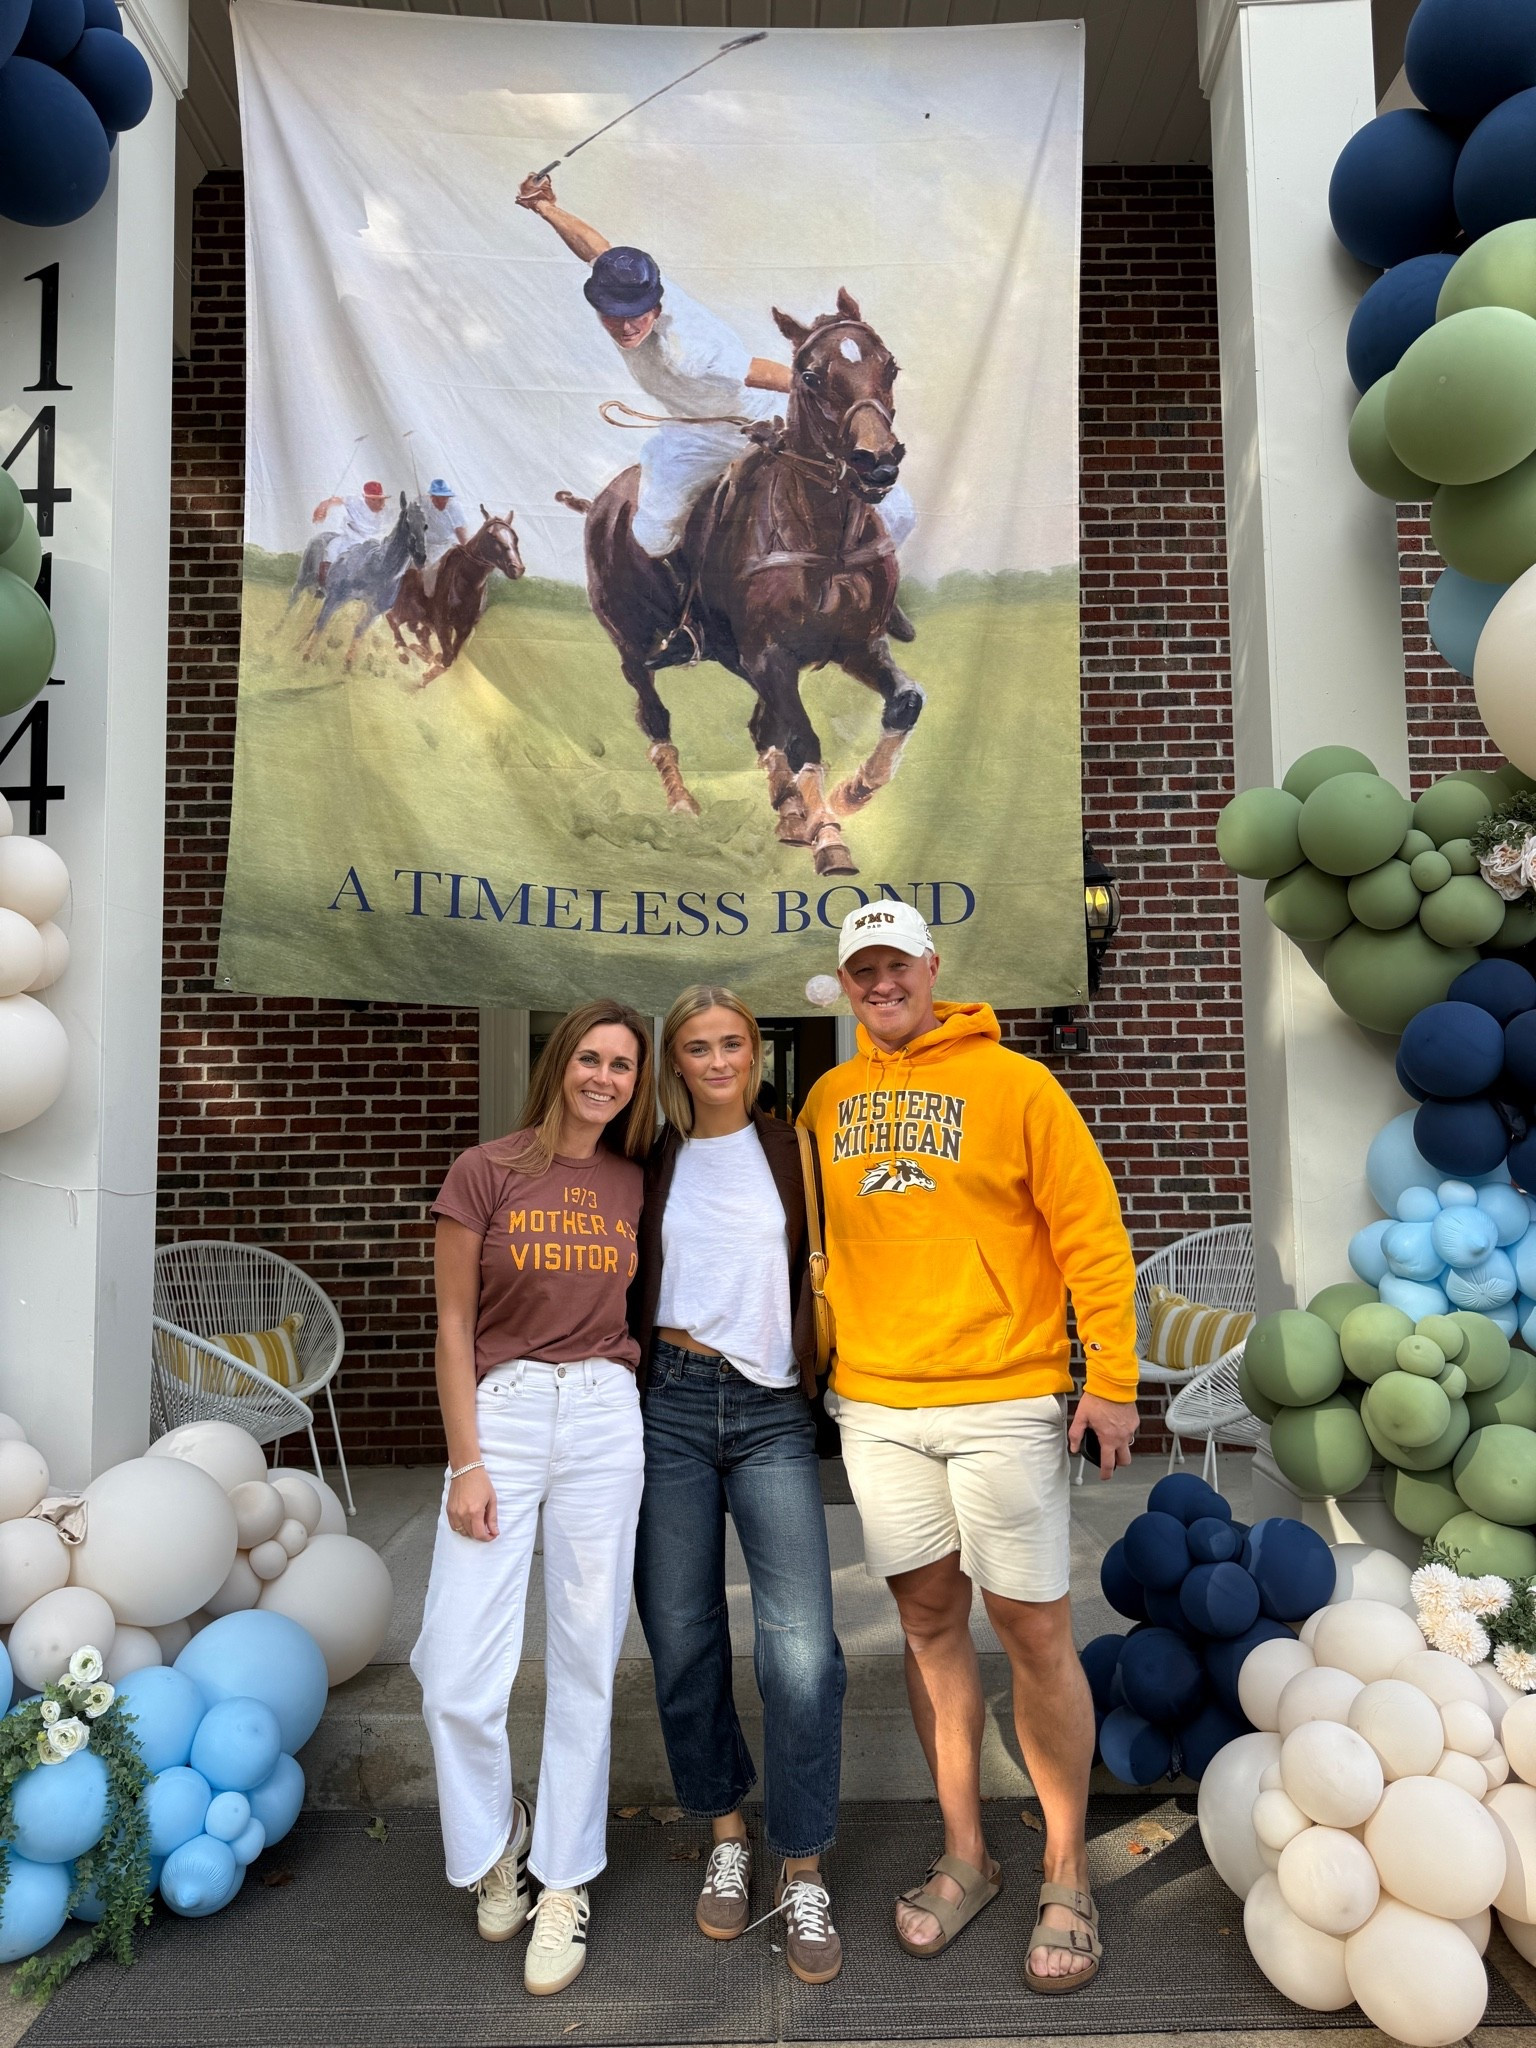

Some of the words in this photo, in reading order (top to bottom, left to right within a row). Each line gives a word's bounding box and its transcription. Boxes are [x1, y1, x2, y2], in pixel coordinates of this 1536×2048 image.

[327, 866, 375, 912] A
[394, 869, 749, 937] TIMELESS
[855, 912, 895, 931] WMU
[838, 1090, 966, 1128] WESTERN
[832, 1121, 963, 1163] MICHIGAN
[564, 1187, 598, 1209] 1973
[509, 1209, 608, 1235] MOTHER
[510, 1243, 618, 1273] VISITOR
